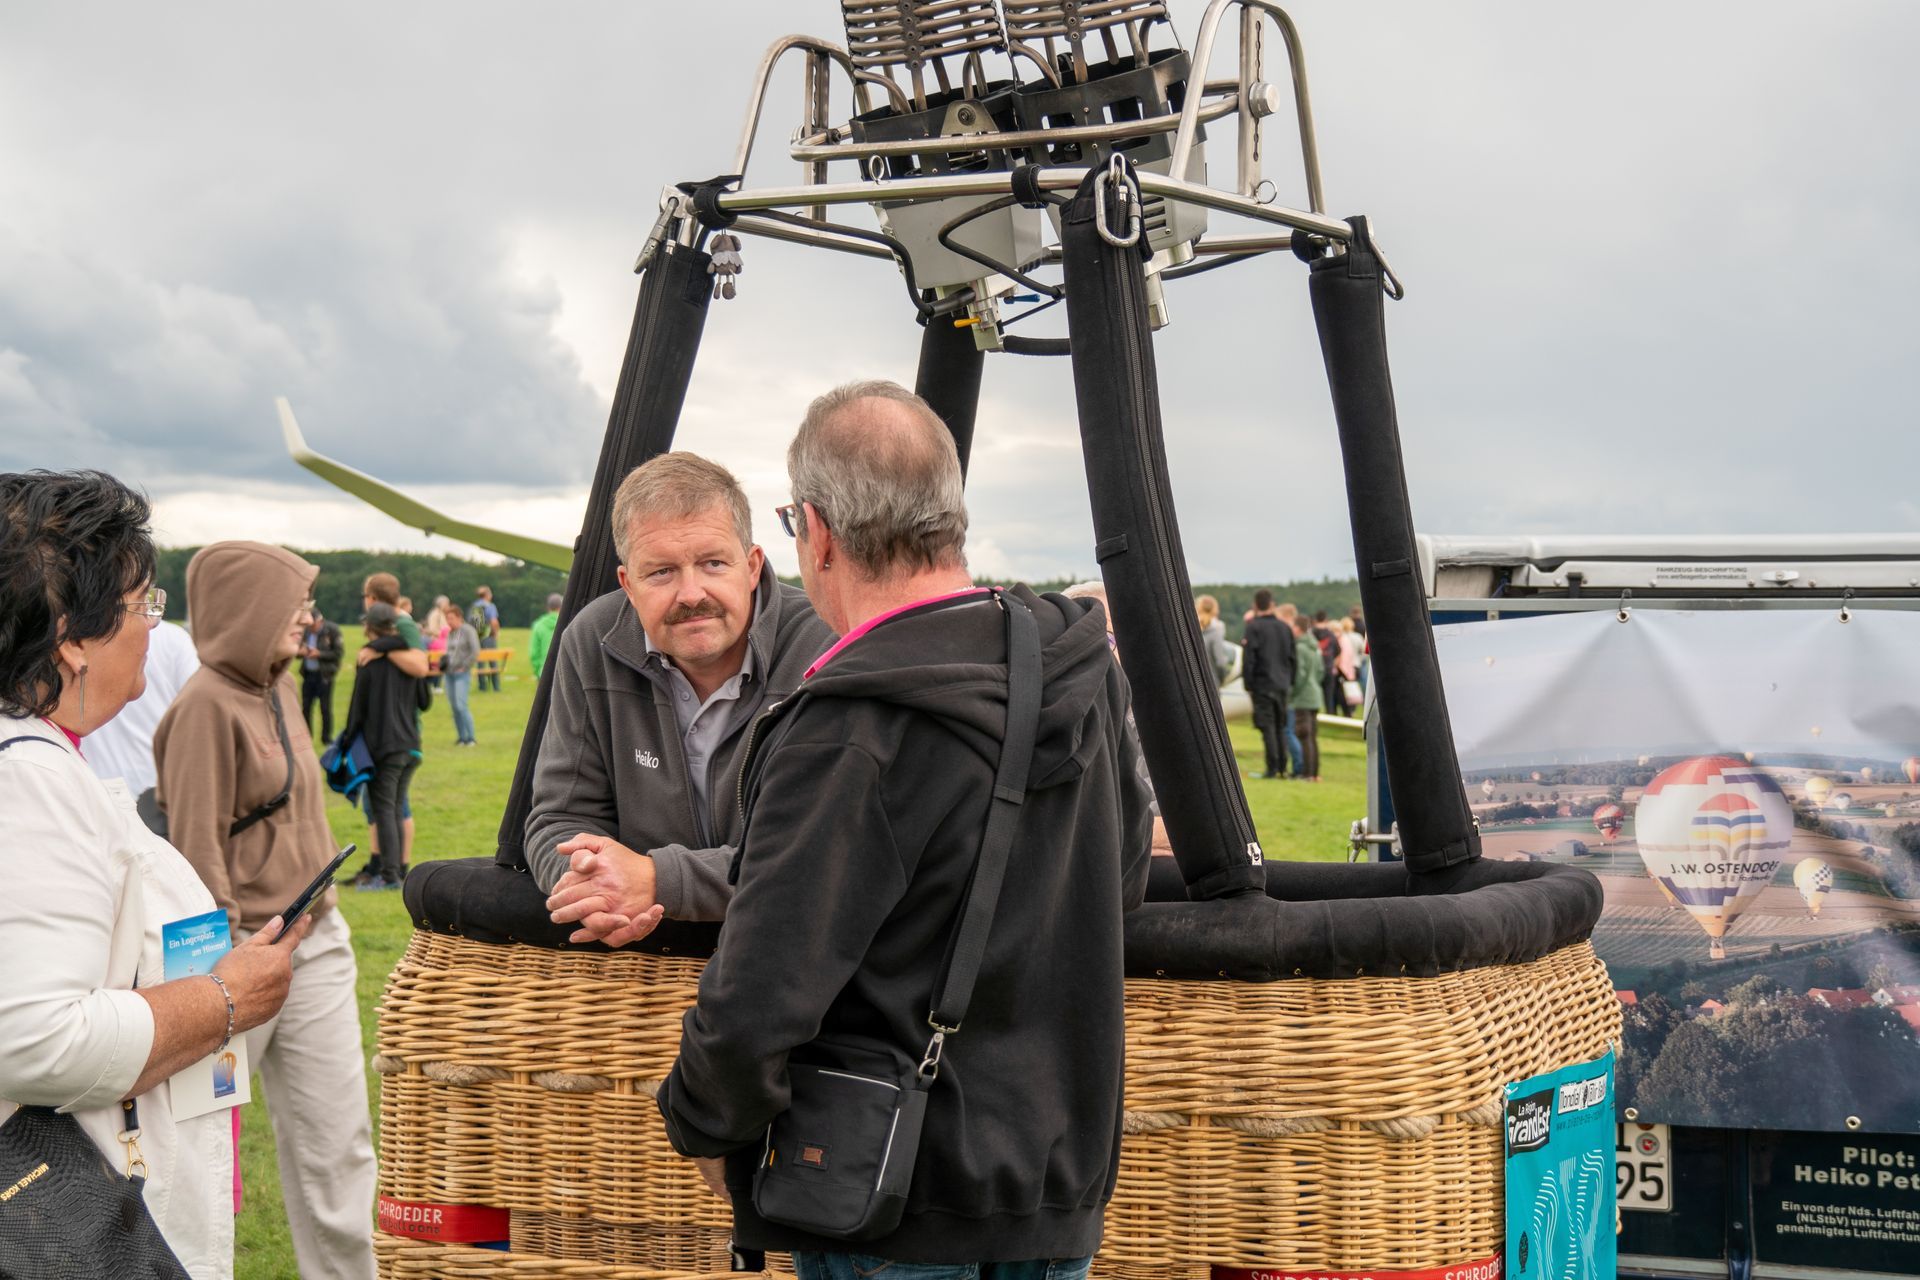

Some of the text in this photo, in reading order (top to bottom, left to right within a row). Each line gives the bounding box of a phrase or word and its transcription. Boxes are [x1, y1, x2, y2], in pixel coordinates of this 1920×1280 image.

[635, 749, 659, 768] Heiko
[169, 931, 215, 949] Ein Logenplatz
[192, 940, 226, 957] am Himmel
[1518, 1105, 1525, 1116] La
[1843, 1147, 1915, 1167] Pilot:
[0, 1163, 49, 1201] MICHAEL KORS
[1616, 1161, 1664, 1201] 95
[1795, 1165, 1870, 1186] Heiko
[378, 1200, 442, 1224] CHROEDER
[1782, 1201, 1801, 1211] Ein
[1803, 1205, 1824, 1213] von
[1826, 1204, 1846, 1214] der
[1848, 1206, 1875, 1217] Nds.
[1796, 1213, 1849, 1227] (NLStbV)
[1851, 1217, 1882, 1228] unter
[1884, 1219, 1905, 1229] der
[1776, 1224, 1851, 1237] genehmigtes
